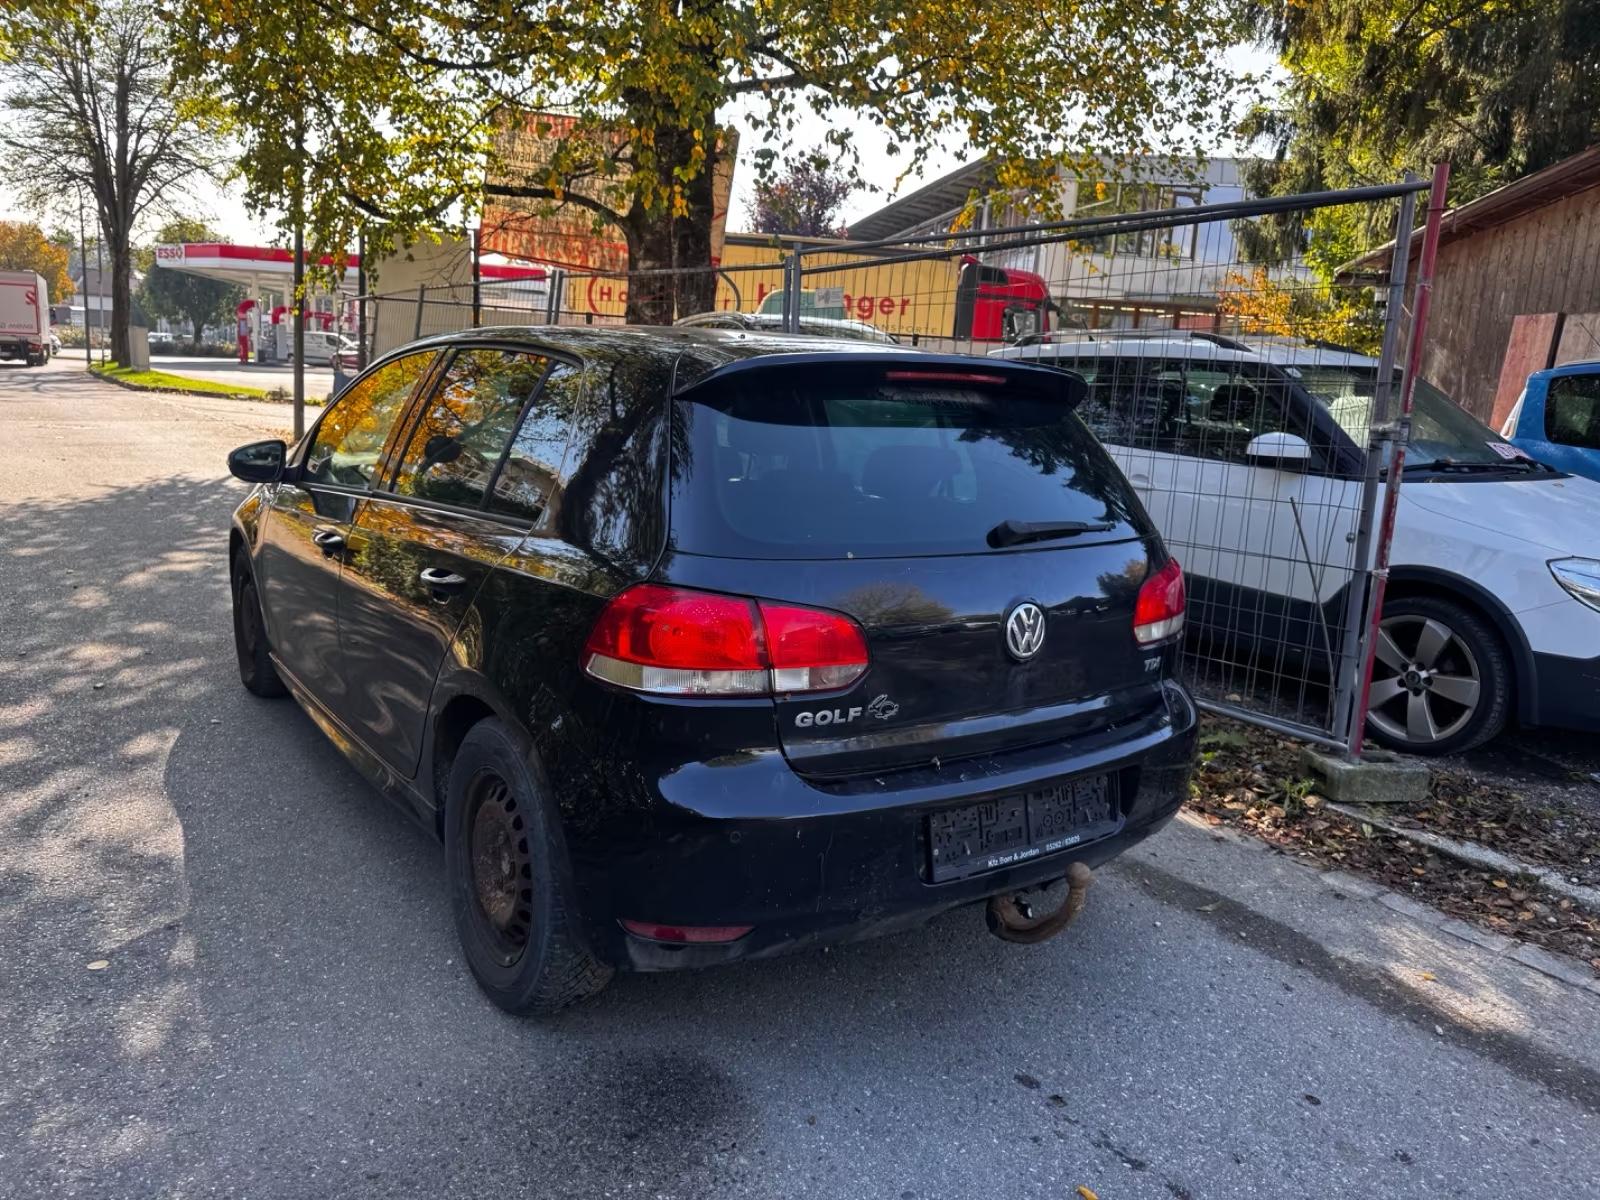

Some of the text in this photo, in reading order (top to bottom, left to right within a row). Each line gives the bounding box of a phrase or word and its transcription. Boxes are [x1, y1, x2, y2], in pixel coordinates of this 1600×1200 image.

[794, 706, 863, 728] GOLF
[1013, 852, 1019, 861] &
[1019, 848, 1040, 859] Jordan
